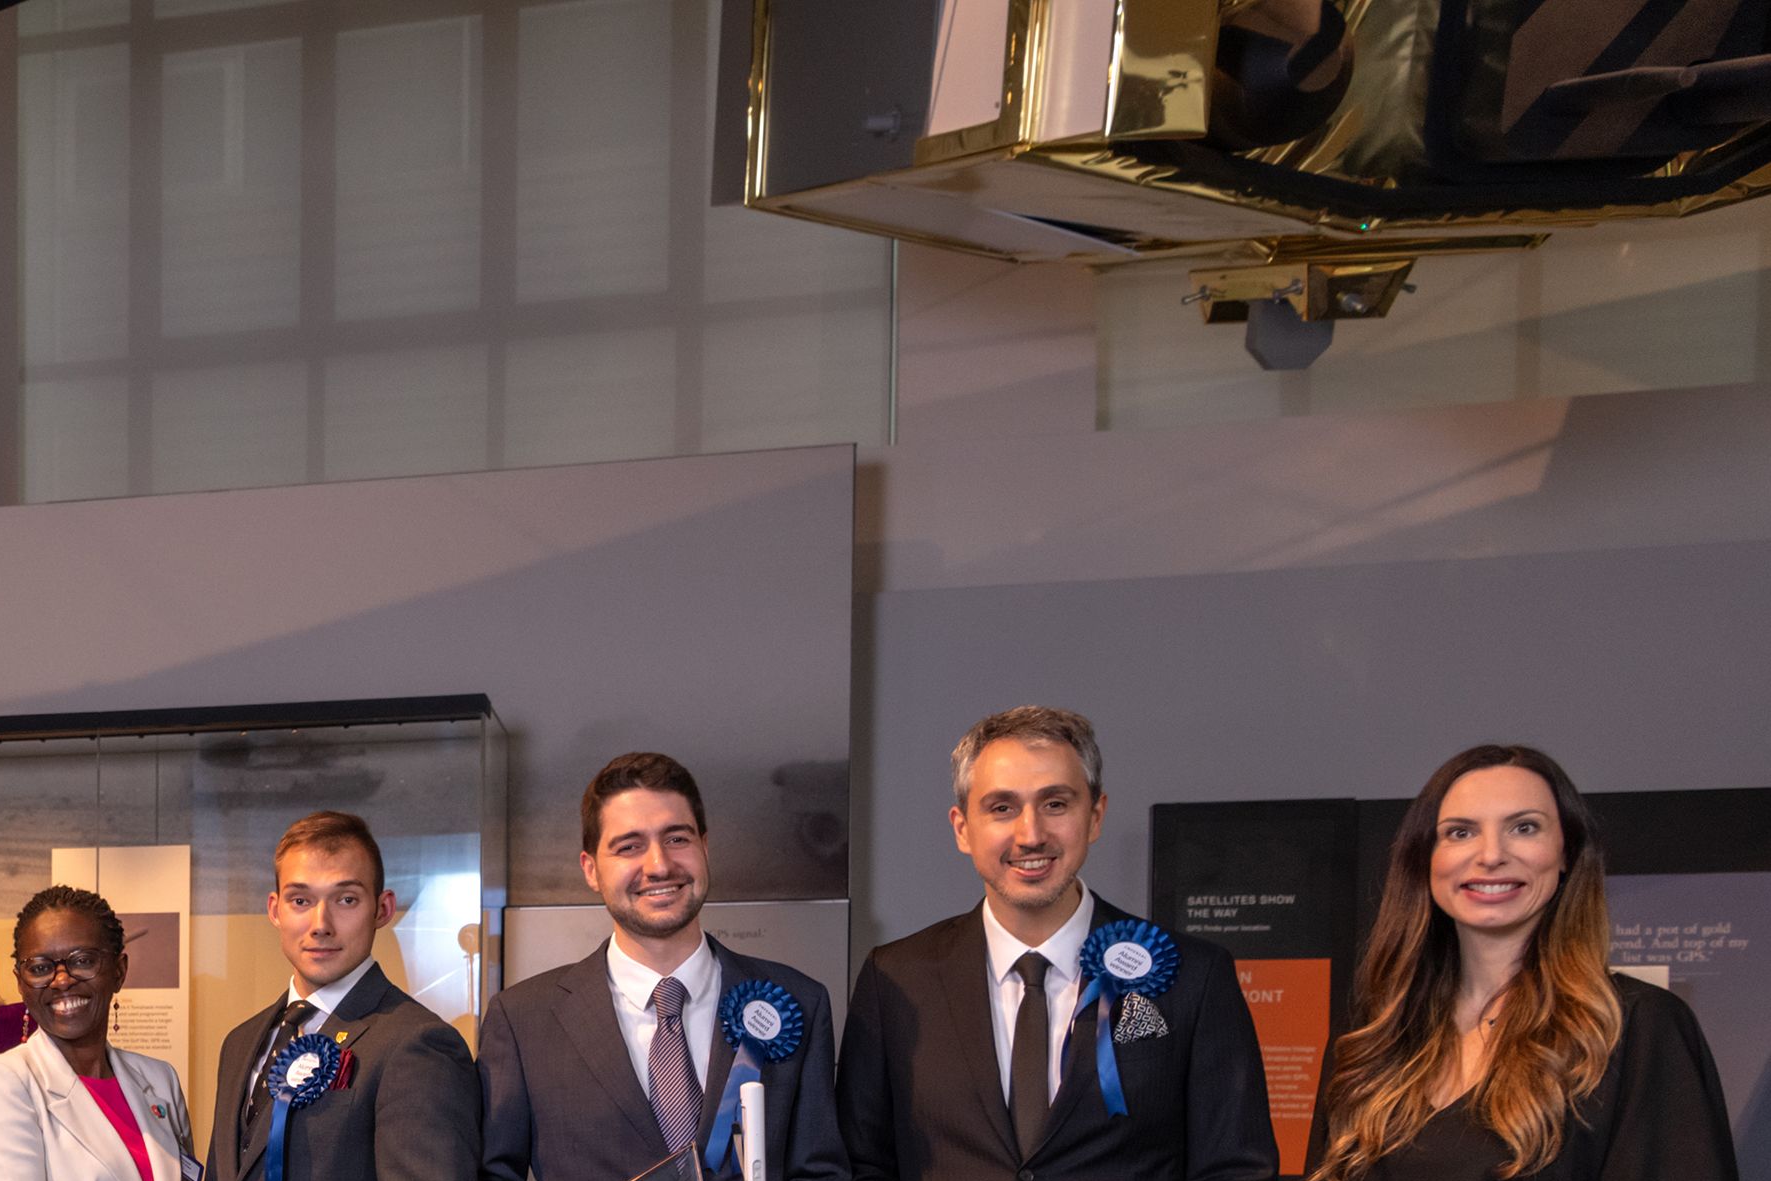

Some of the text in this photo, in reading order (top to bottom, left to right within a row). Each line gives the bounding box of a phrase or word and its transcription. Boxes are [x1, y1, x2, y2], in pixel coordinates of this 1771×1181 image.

[1186, 894, 1296, 906] SATELLITES SHOW
[1186, 908, 1238, 918] THE WAY
[1615, 922, 1732, 939] had a pot of gold
[1610, 936, 1749, 951] pend. And top of my
[1114, 956, 1138, 971] Award
[1117, 951, 1144, 966] Alumni
[1622, 951, 1642, 962] list
[1646, 953, 1672, 962] was
[751, 1015, 770, 1032] Award
[753, 1009, 775, 1027] Alumni
